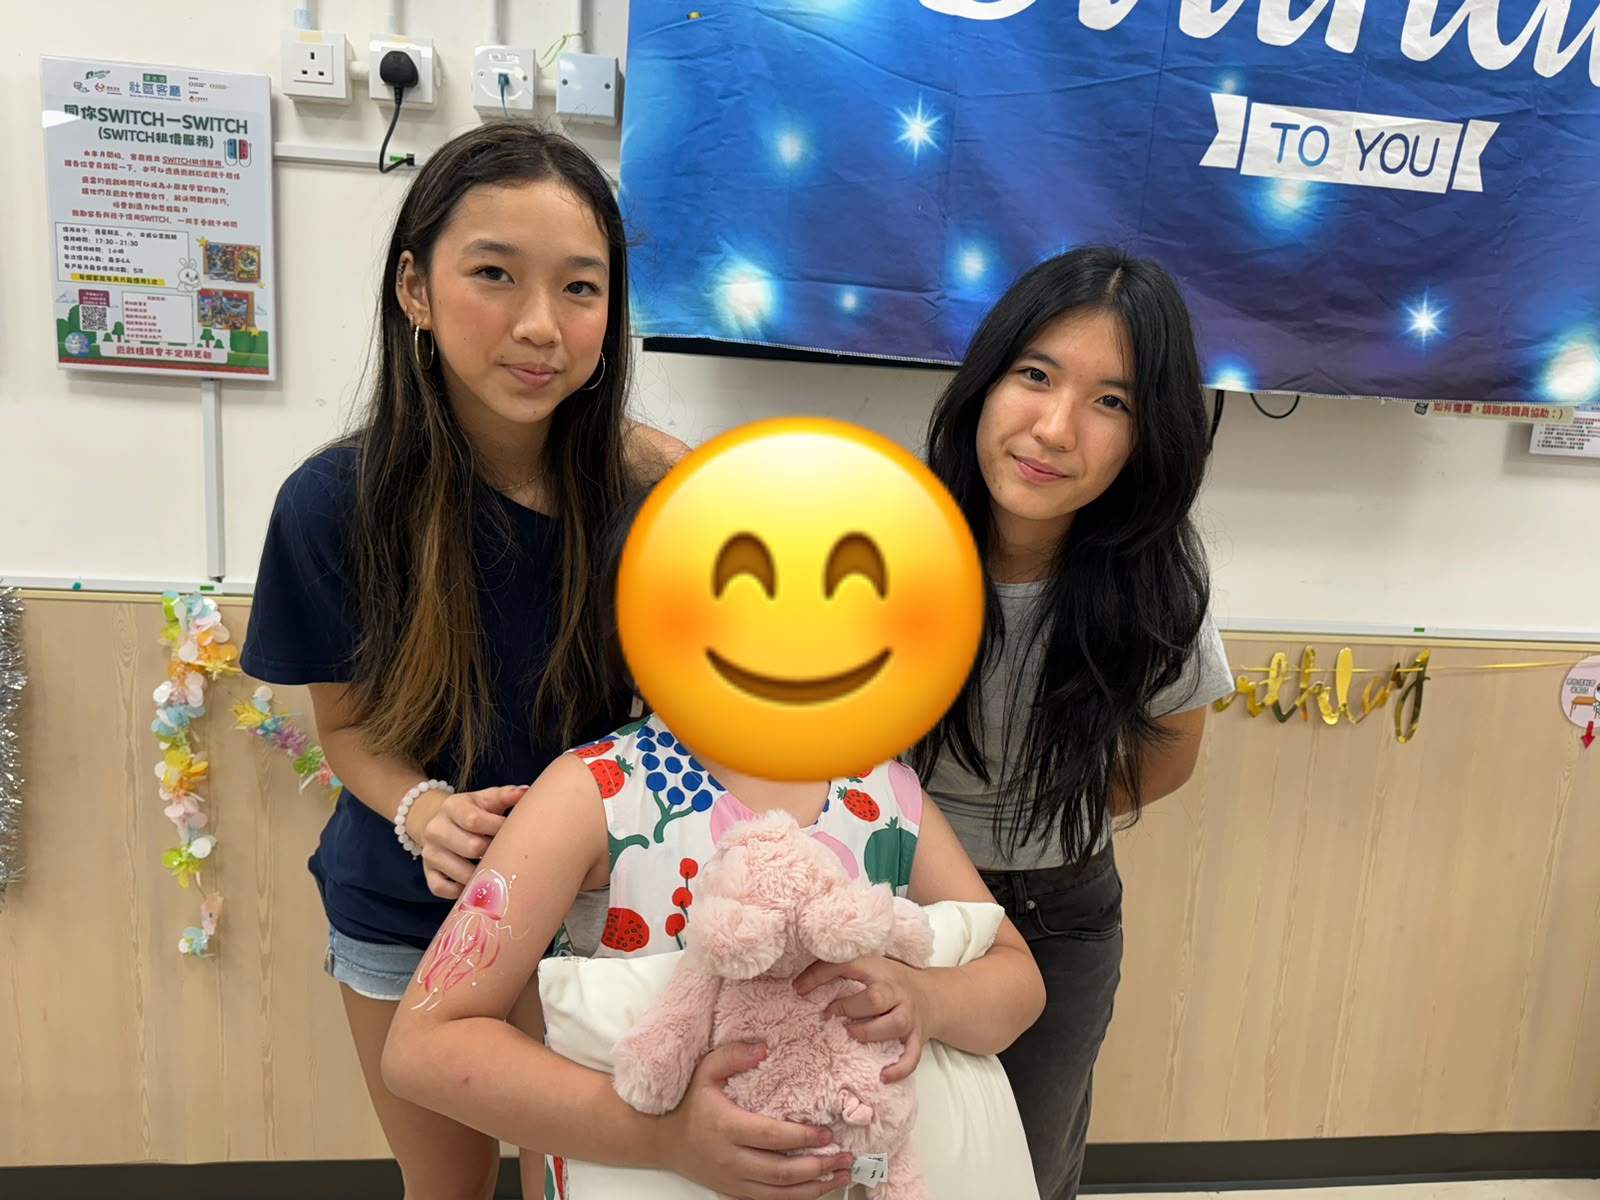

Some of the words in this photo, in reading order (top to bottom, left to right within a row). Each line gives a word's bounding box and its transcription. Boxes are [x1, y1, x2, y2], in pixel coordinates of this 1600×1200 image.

[129, 81, 182, 97] 社區客廳
[1269, 122, 1330, 168] TO
[1355, 128, 1442, 179] YOU
